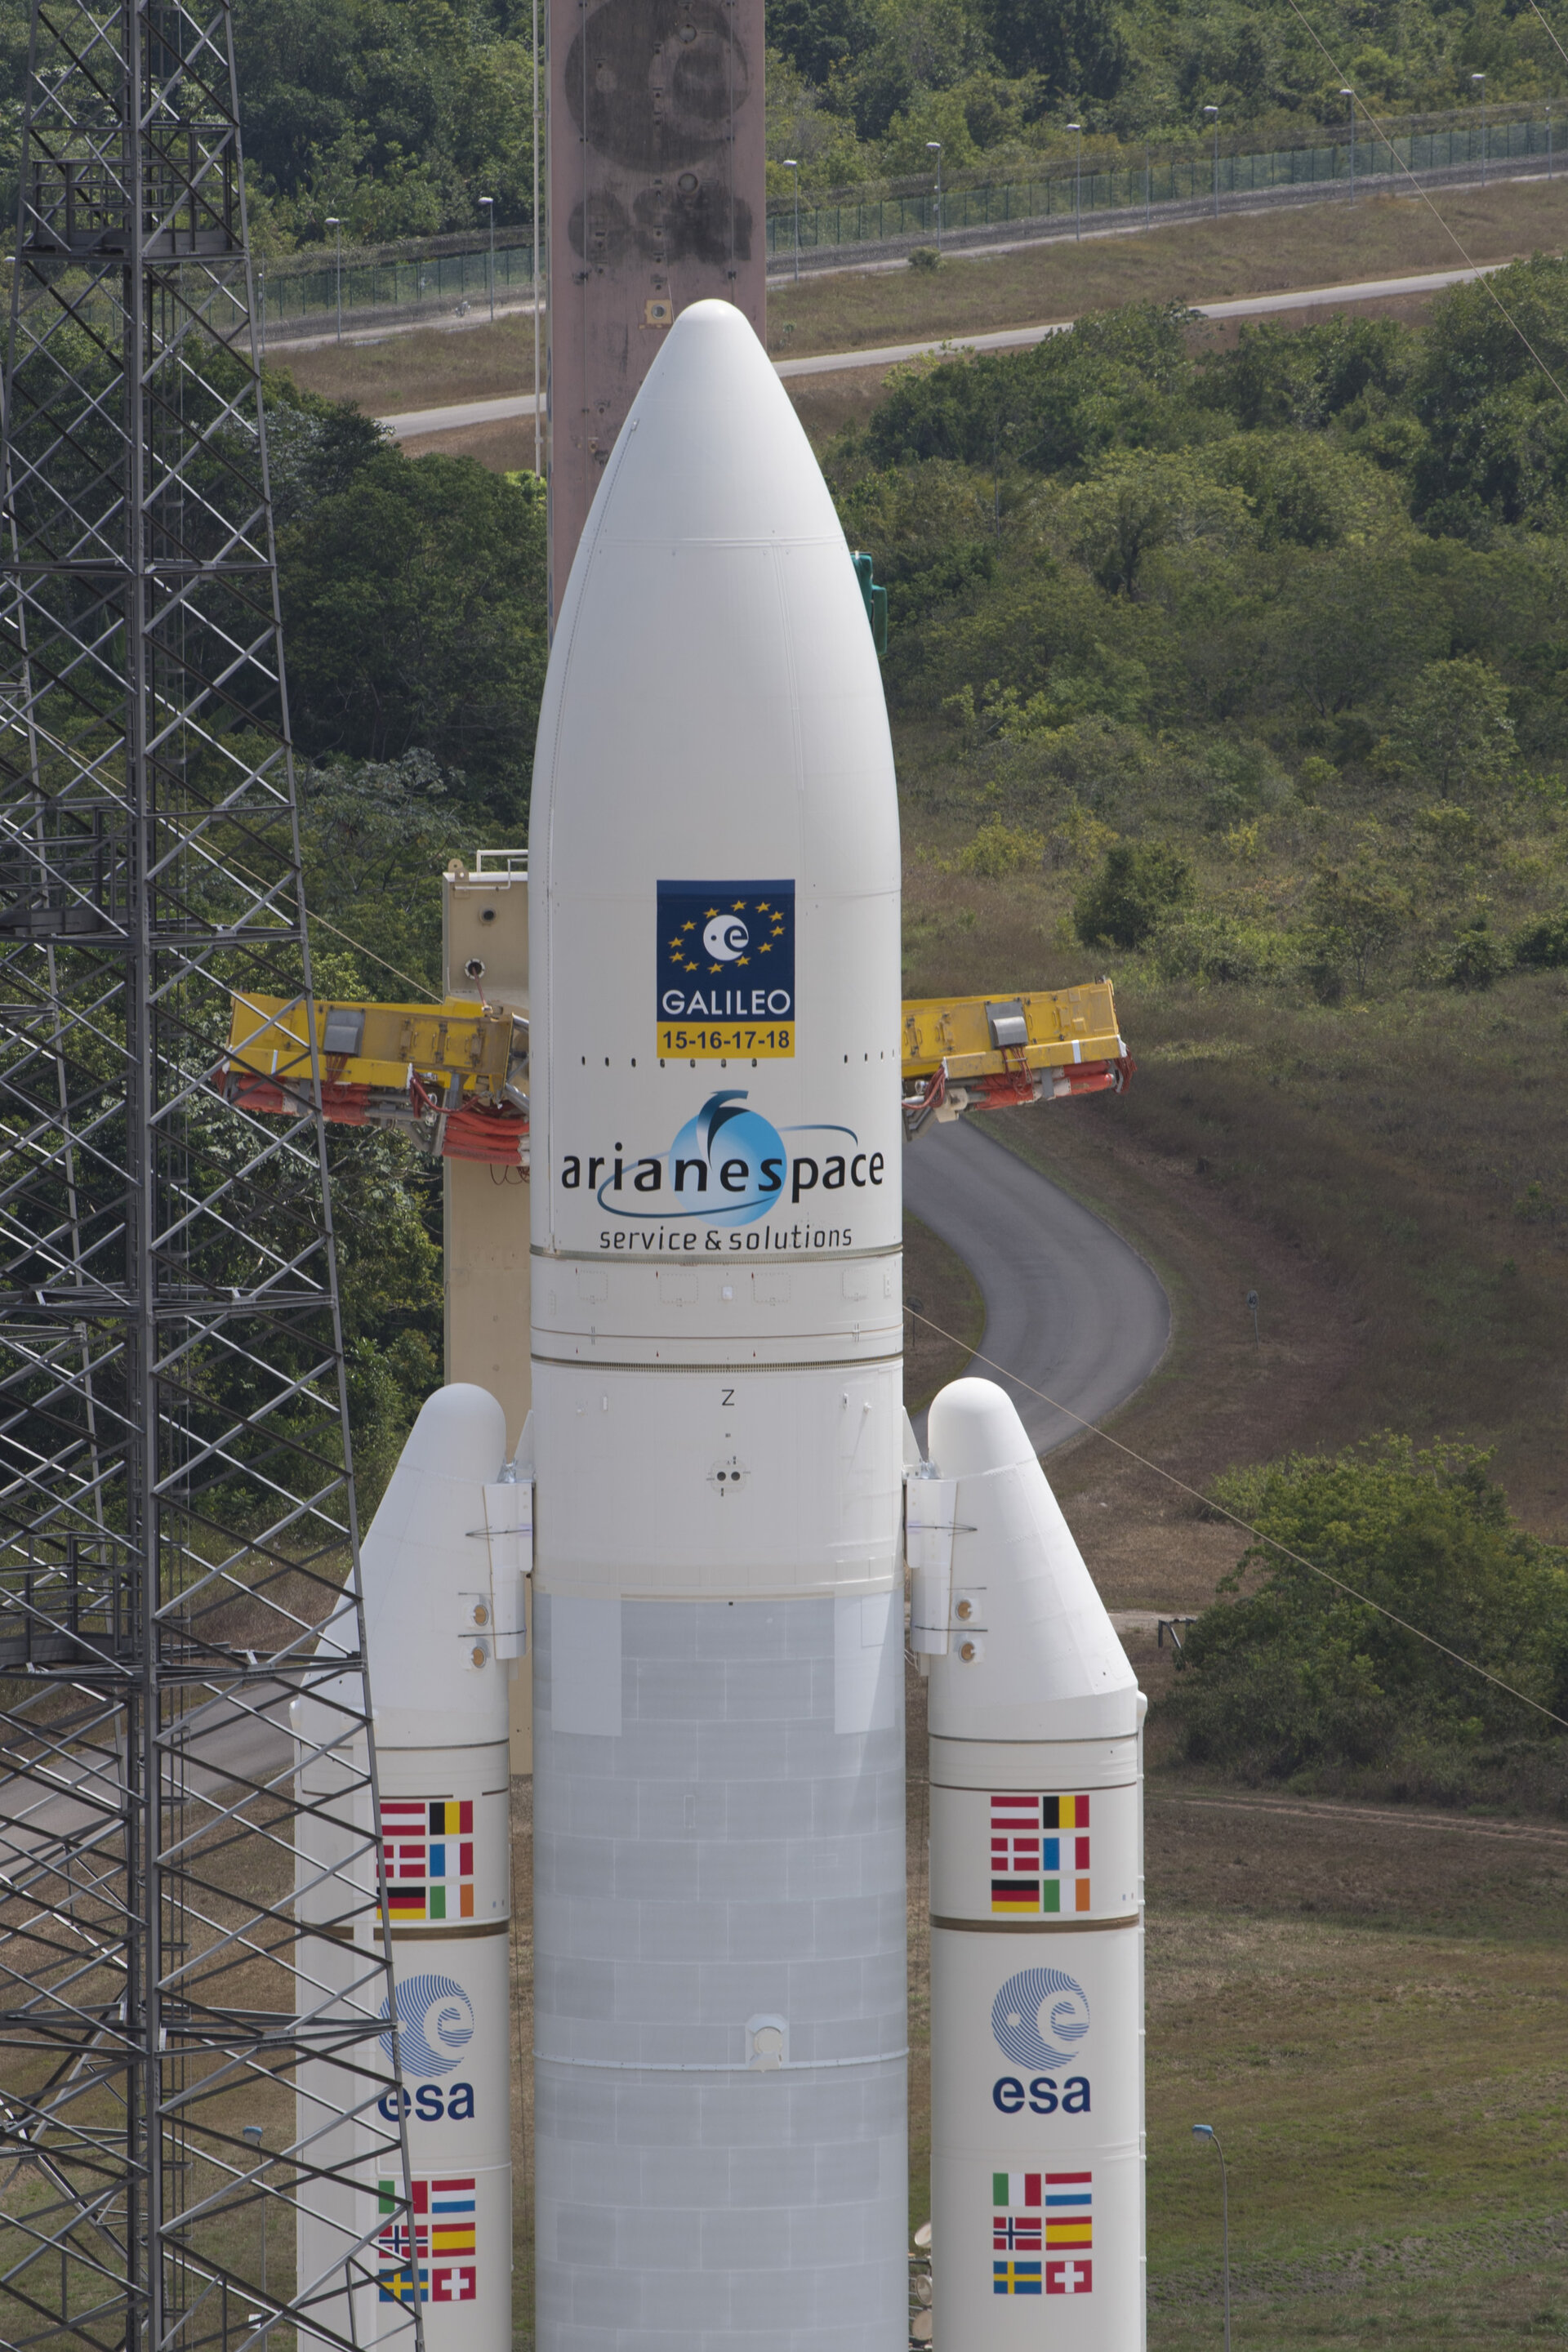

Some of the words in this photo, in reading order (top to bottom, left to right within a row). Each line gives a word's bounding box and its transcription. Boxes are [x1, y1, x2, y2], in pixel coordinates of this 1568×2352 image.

[662, 989, 791, 1015] GALILEO
[662, 1031, 790, 1050] 15-16-17-18
[561, 1141, 884, 1203] arianespace
[599, 1226, 697, 1251] service
[705, 1230, 722, 1251] &
[728, 1225, 852, 1251] solutions
[721, 1388, 735, 1406] Z
[377, 2082, 474, 2122] esa
[991, 2076, 1092, 2115] esa
